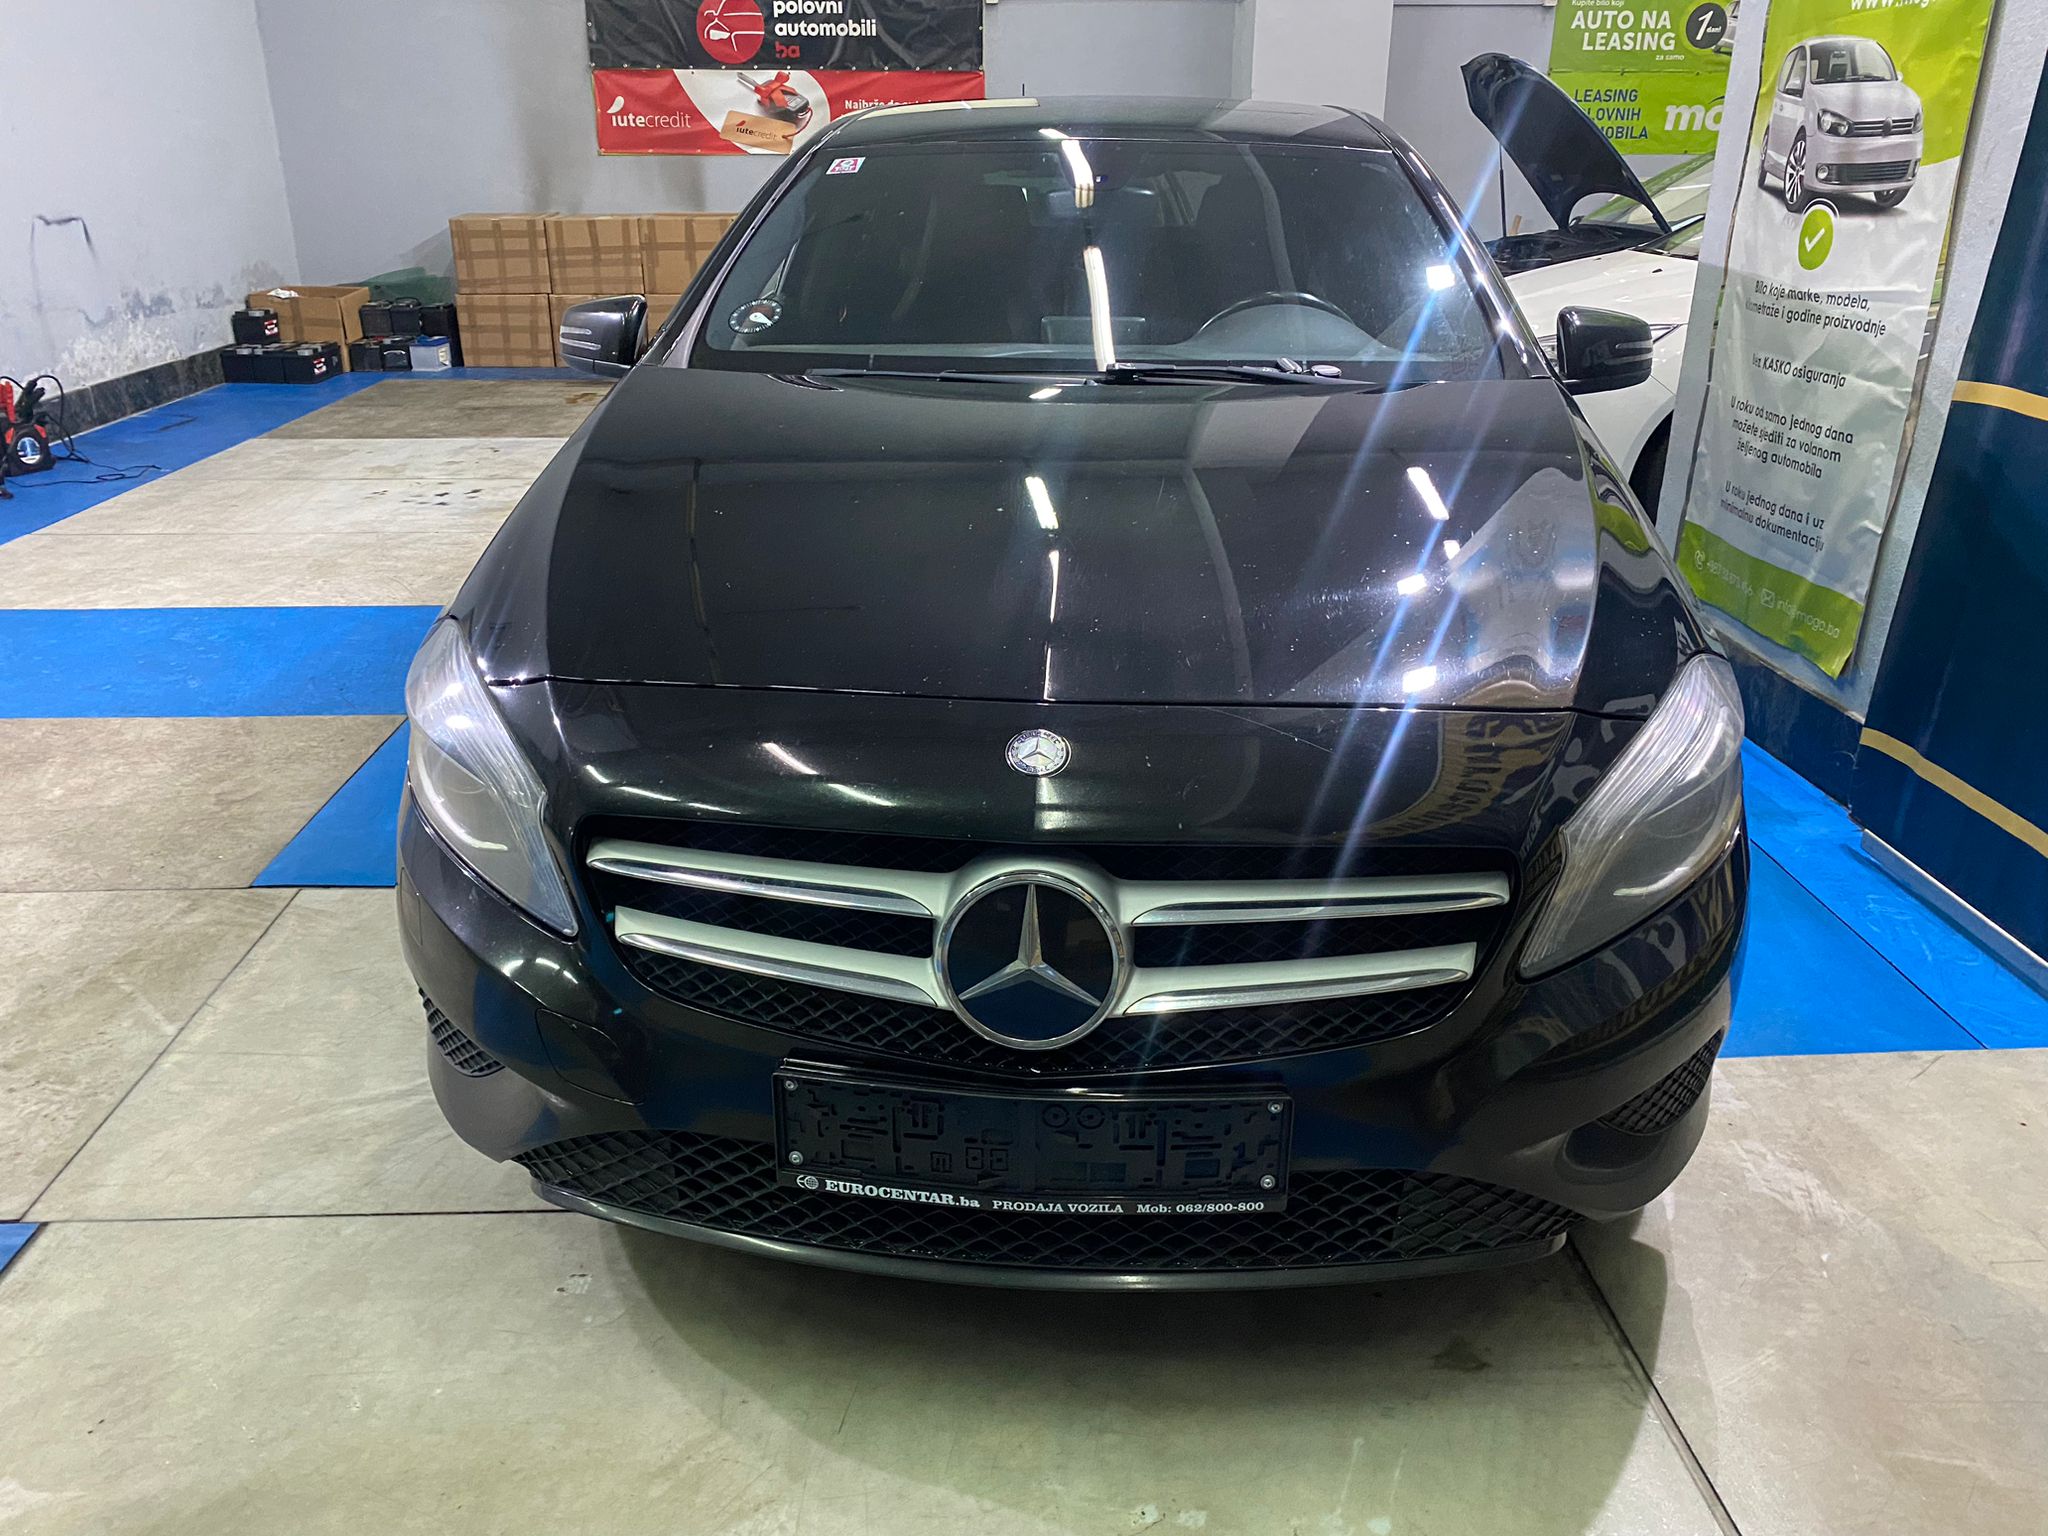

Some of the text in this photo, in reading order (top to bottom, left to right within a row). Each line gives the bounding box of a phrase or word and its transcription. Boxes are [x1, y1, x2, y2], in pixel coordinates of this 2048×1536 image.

[773, 0, 843, 17] polovni
[1571, 10, 1672, 29] AUTO NA
[774, 19, 877, 37] automobili
[1695, 10, 1714, 41] 1
[1582, 32, 1676, 51] LEASING
[1574, 89, 1639, 102] LEASING
[1583, 108, 1641, 121] LOVNIH
[1769, 284, 1786, 301] koje
[1787, 288, 1823, 305] marke,
[1826, 293, 1871, 312] modela,
[1786, 308, 1822, 324] godine
[1823, 314, 1886, 338] proizvodnje
[1763, 357, 1792, 375] KASKO
[1791, 365, 1847, 389] osiguranja
[1730, 395, 1854, 444] U roku od samo jednog dana
[1731, 418, 1842, 463] možete sjediti za volanom
[1736, 437, 1823, 479] željenog automobila
[1725, 480, 1732, 493] U
[1745, 490, 1777, 516] jednog
[1778, 503, 1804, 524] dana
[1812, 517, 1826, 530] uz
[1754, 514, 1825, 553] dokumentaciju
[824, 1179, 1265, 1214] EUROCENTAR.ba PRODAJA VOZILA Mob: 062/800-800
